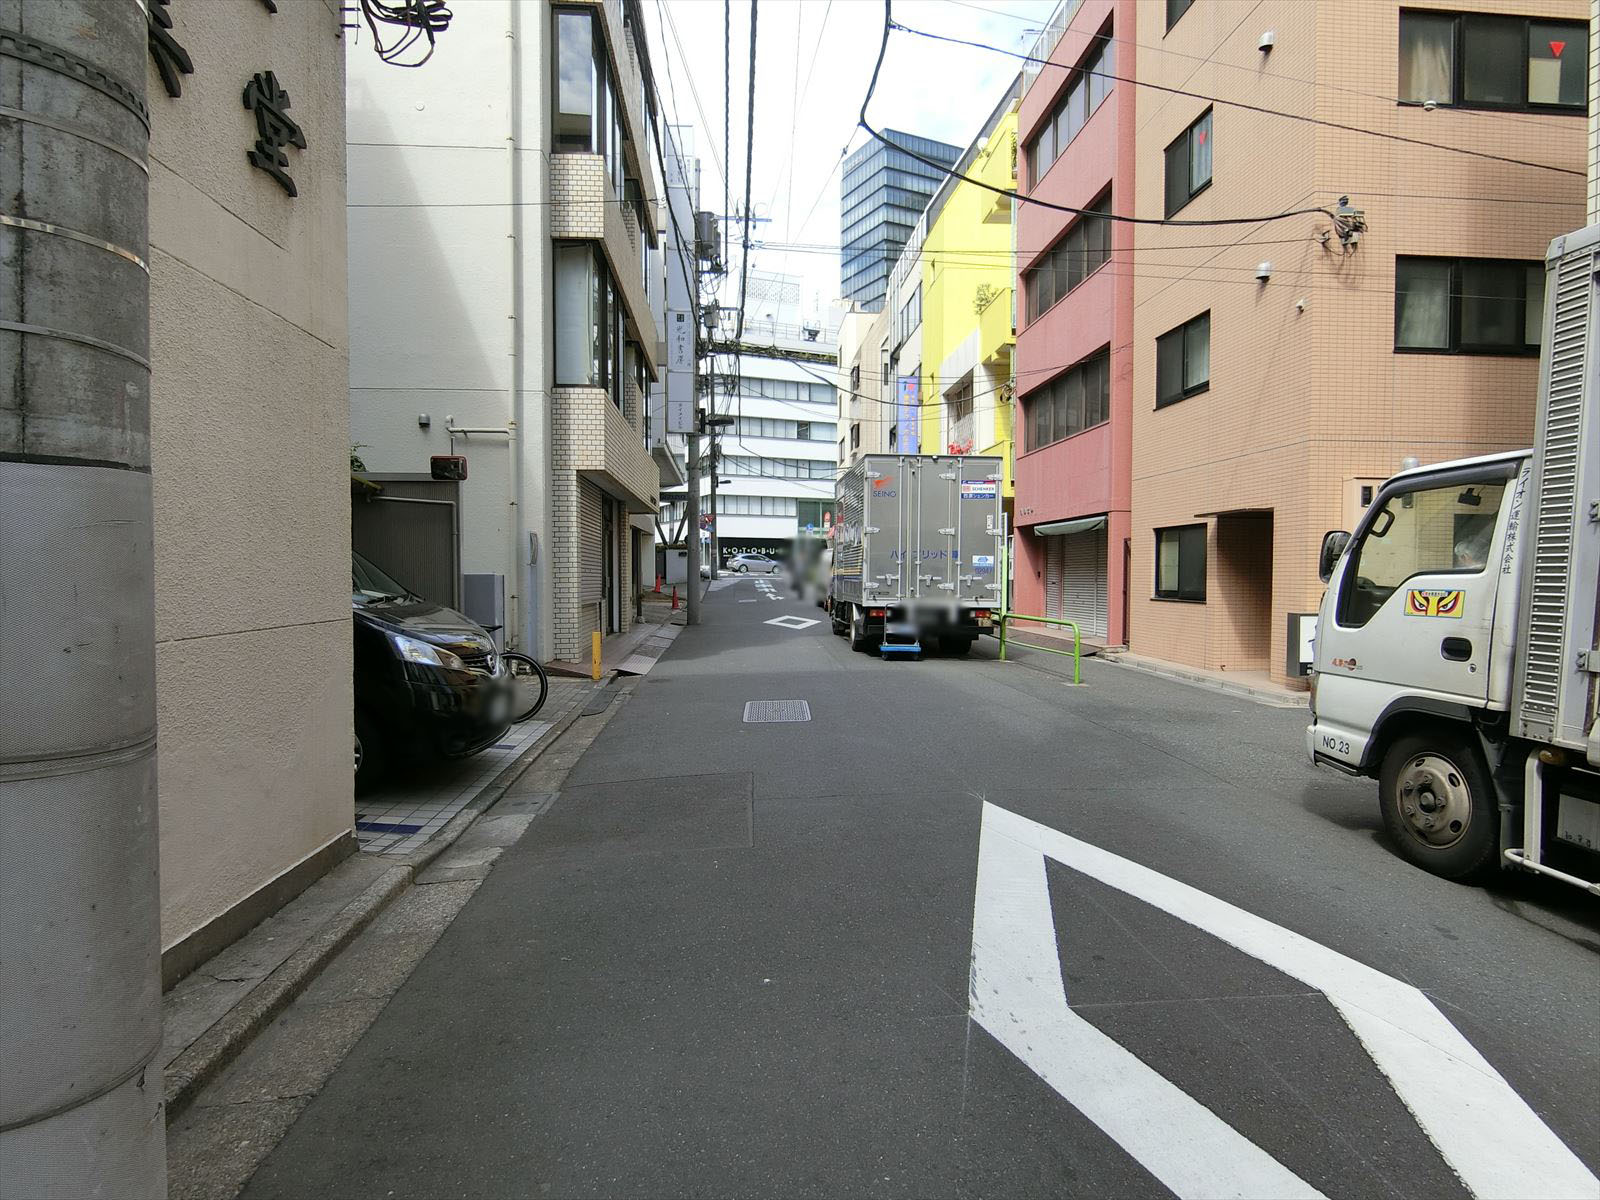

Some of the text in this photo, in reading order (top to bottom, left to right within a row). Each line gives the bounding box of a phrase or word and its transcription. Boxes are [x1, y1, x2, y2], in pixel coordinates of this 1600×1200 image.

[873, 490, 897, 498] SEINO
[1502, 467, 1532, 575] ライオン運輸株式会社
[1322, 735, 1350, 755] NO.23
